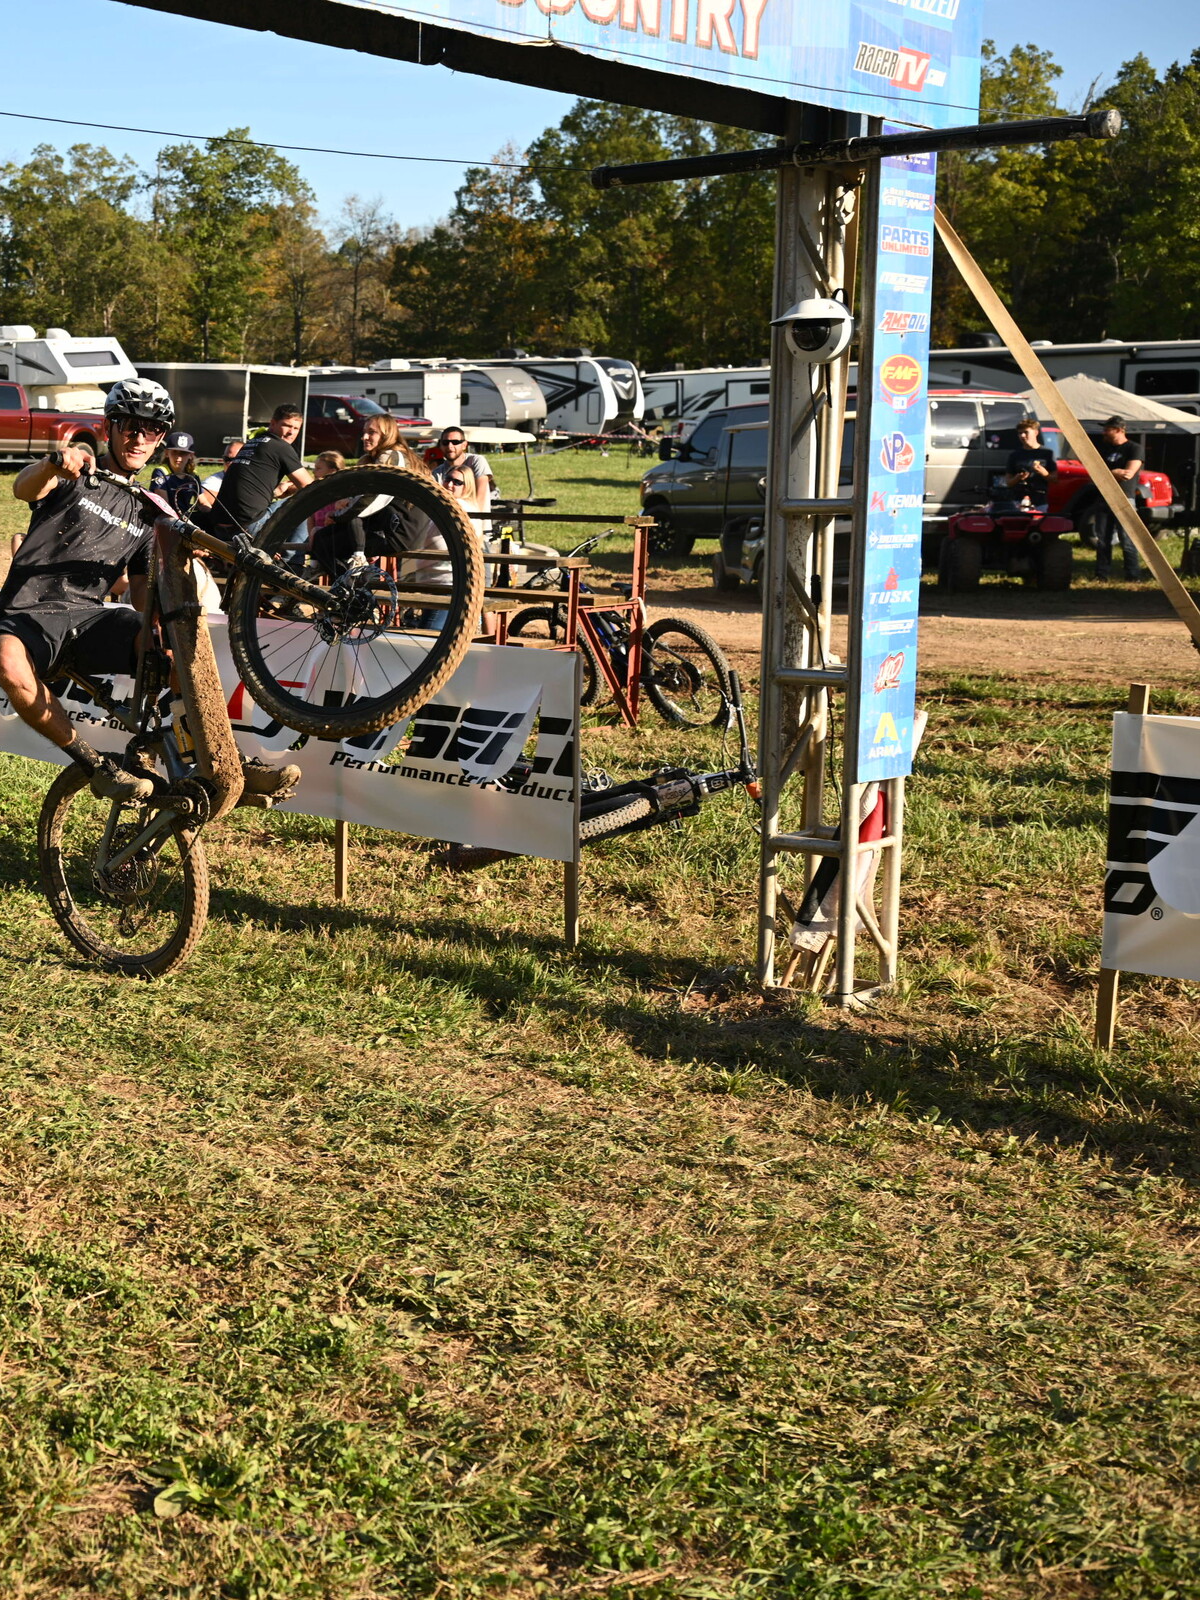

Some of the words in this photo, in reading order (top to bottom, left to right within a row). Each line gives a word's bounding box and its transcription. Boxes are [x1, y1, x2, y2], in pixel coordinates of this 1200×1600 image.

[882, 226, 929, 246] PARTS
[881, 241, 929, 256] UNLIMITED
[880, 312, 927, 331] AMSOIL
[883, 366, 919, 380] FMF
[883, 433, 905, 471] VP
[78, 497, 103, 516] PRO
[887, 494, 923, 508] KENDA
[869, 590, 914, 605] TUSK
